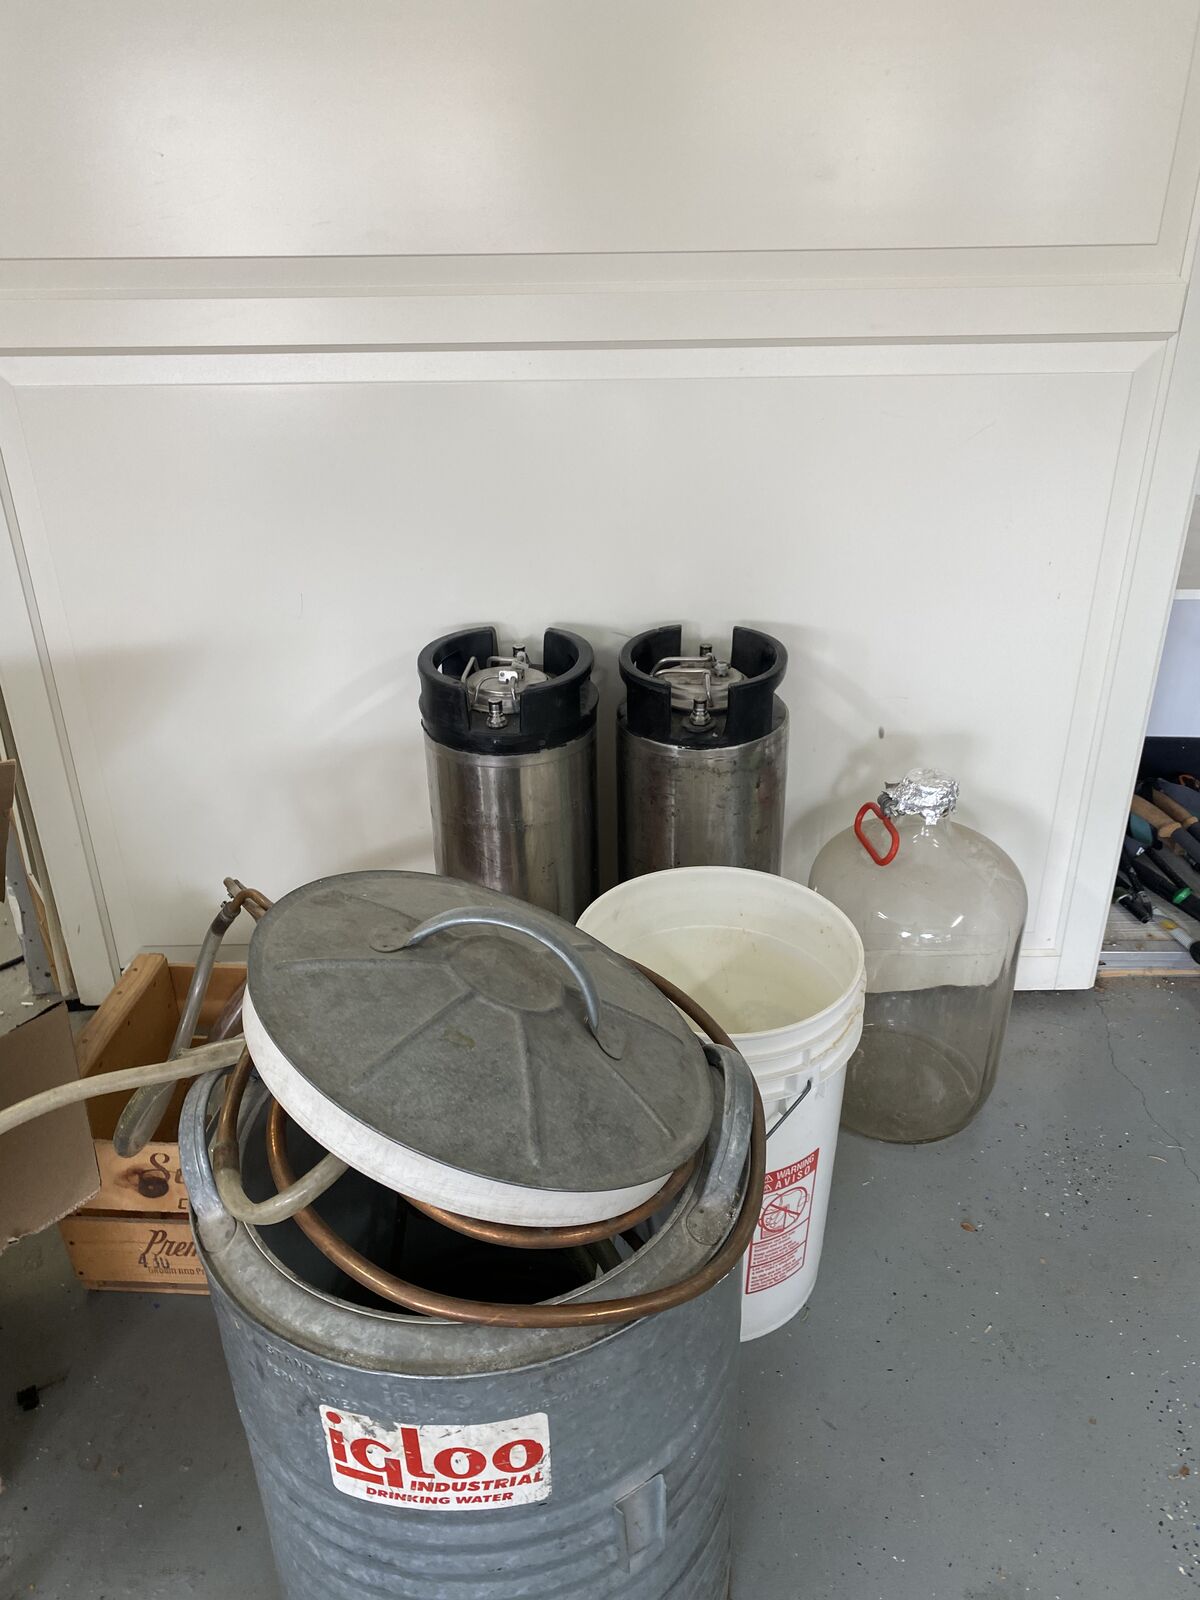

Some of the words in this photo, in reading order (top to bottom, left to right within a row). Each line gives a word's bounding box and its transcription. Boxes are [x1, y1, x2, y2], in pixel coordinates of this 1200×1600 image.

[775, 1165, 811, 1190] AVISO
[776, 1153, 815, 1180] WARNING
[325, 1411, 545, 1489] igloo
[410, 1470, 544, 1493] INDUSTRIAL
[366, 1486, 450, 1505] DRINKING
[455, 1491, 514, 1504] WATER
